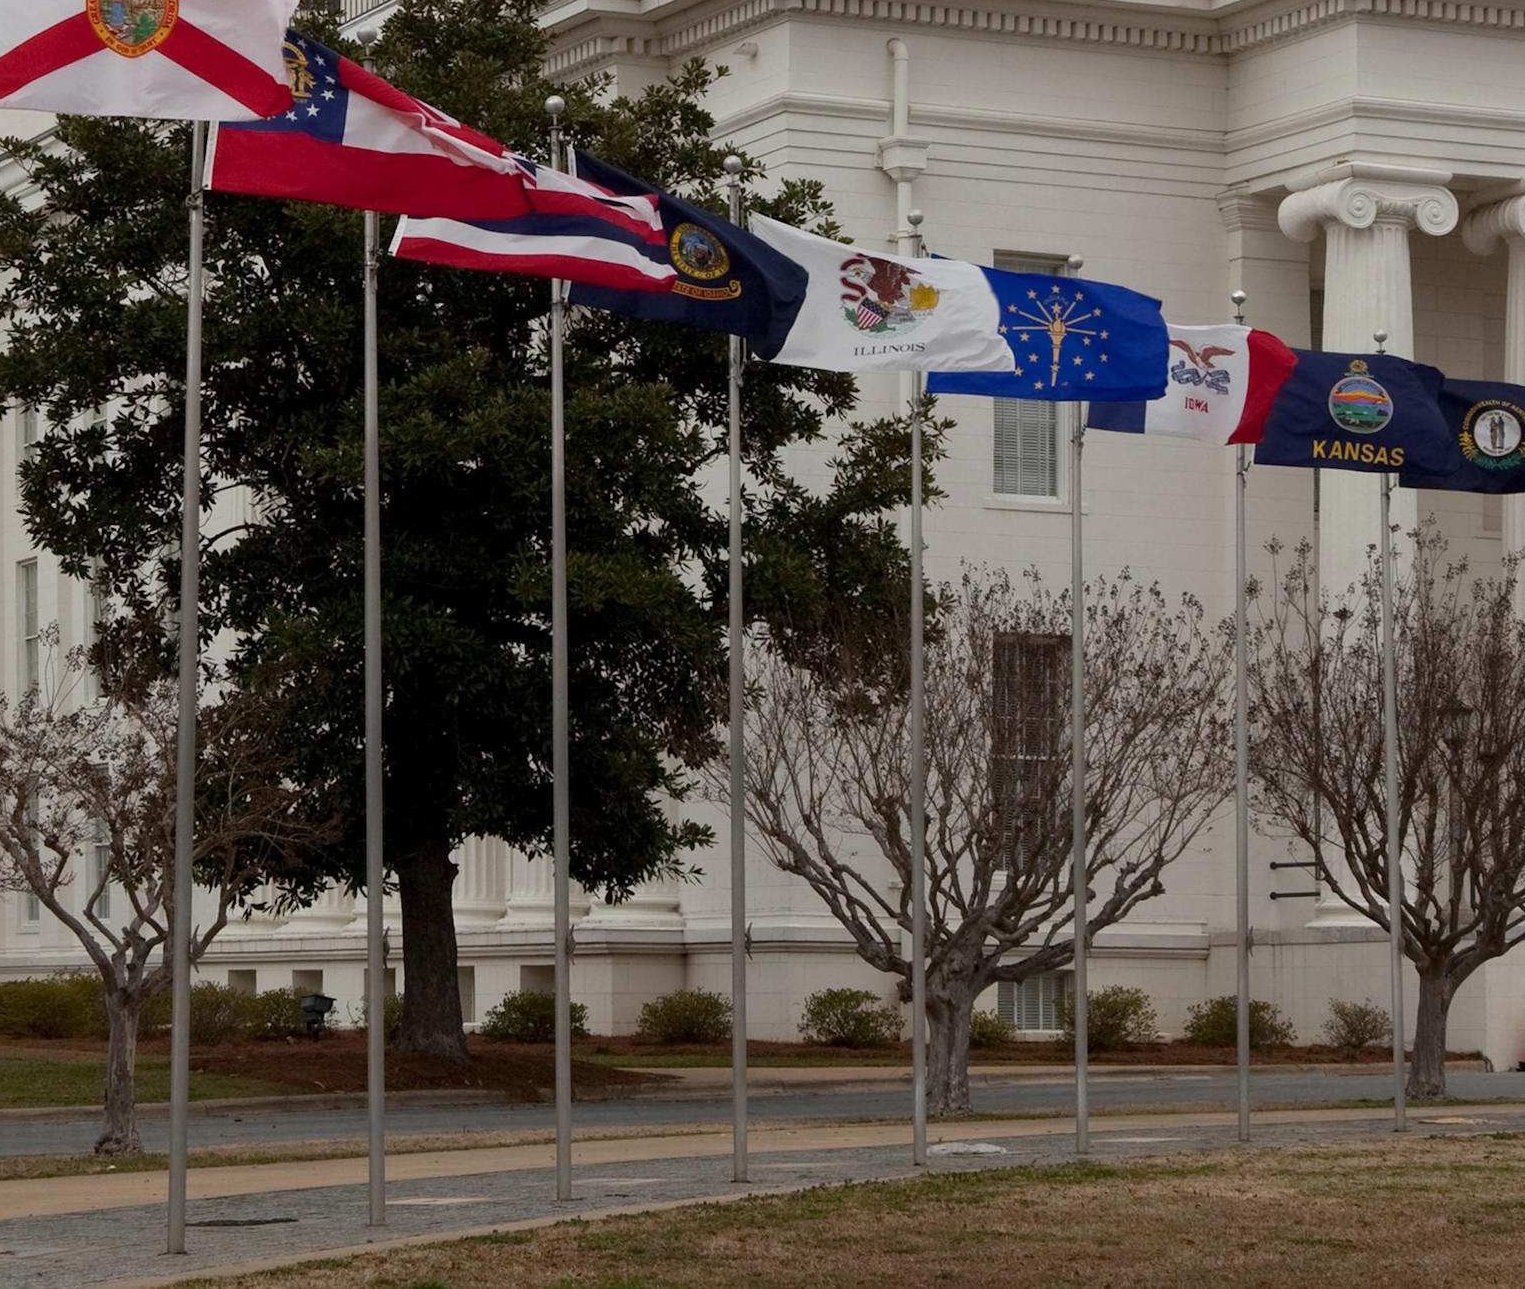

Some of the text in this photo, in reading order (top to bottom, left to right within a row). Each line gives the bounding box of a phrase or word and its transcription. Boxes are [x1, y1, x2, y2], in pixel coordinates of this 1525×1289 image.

[854, 343, 927, 357] ILLINOIS
[1185, 397, 1209, 414] IOWA
[1312, 440, 1405, 467] KANSAS
